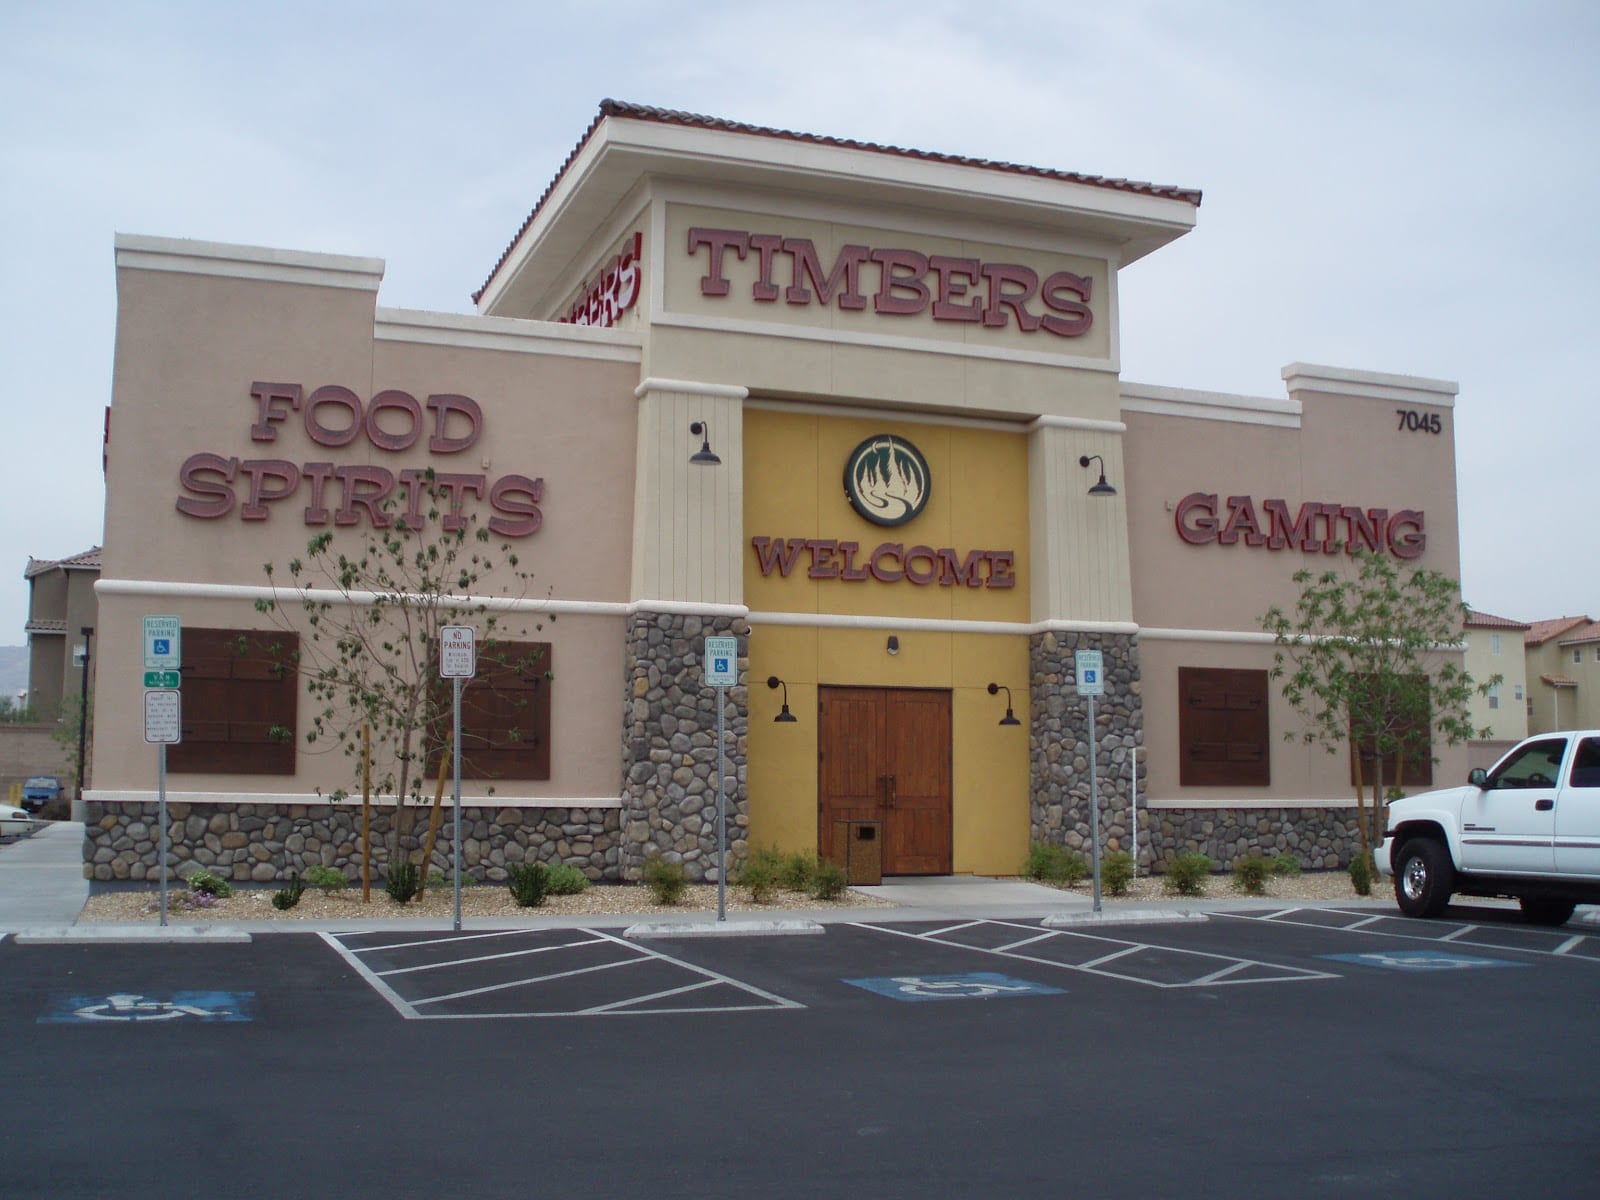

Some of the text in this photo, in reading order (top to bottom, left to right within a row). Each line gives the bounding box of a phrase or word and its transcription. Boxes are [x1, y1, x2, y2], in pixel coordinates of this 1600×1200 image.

[687, 227, 1094, 338] TIMBERS
[250, 381, 484, 454] FOOD
[1397, 410, 1442, 434] 7045
[176, 452, 545, 538] SPIRITS
[1175, 492, 1427, 560] GAMING
[752, 536, 1016, 589] WELCOME
[146, 620, 177, 629] RESERVED
[148, 629, 175, 638] PARKING
[453, 631, 462, 639] NO
[443, 641, 470, 649] PARKING
